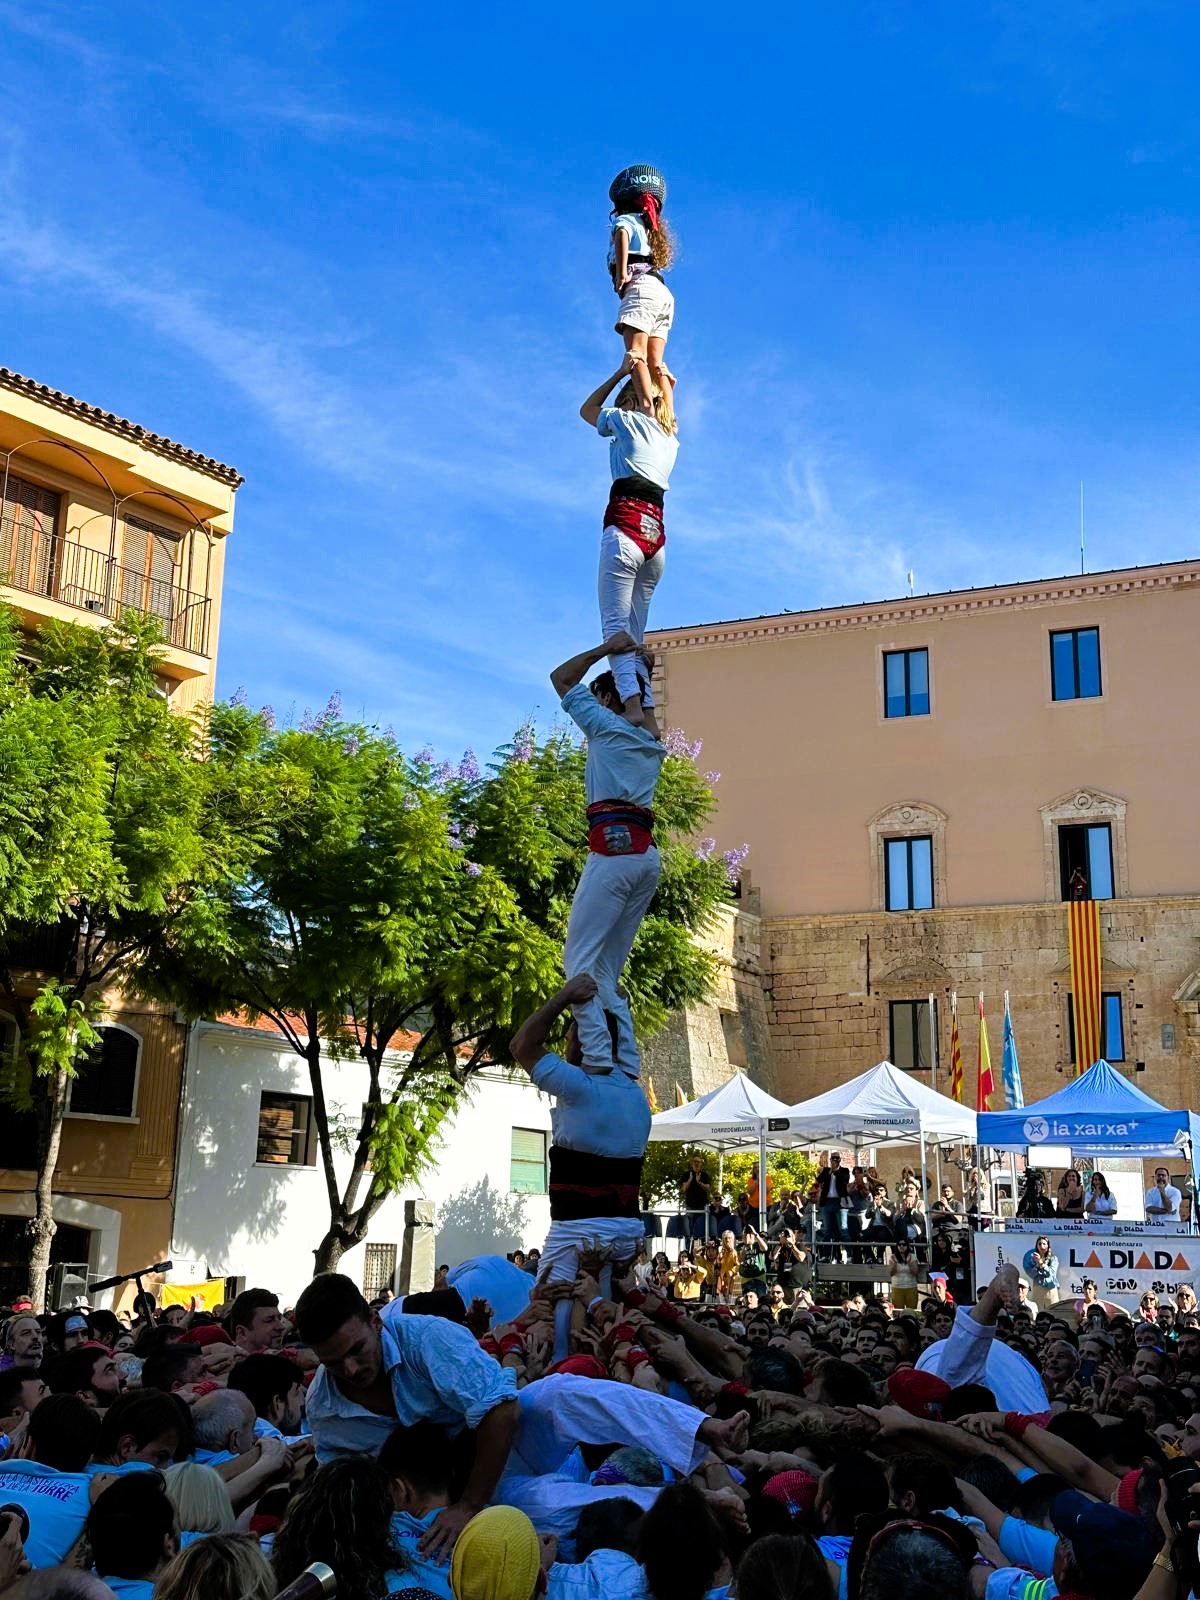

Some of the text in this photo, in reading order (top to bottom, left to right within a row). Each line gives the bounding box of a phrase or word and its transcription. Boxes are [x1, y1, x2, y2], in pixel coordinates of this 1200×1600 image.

[630, 175, 660, 185] NOIS
[1053, 1120, 1070, 1136] la
[1069, 1249, 1191, 1270] LA DIADA
[32, 1484, 73, 1502] TORRE
